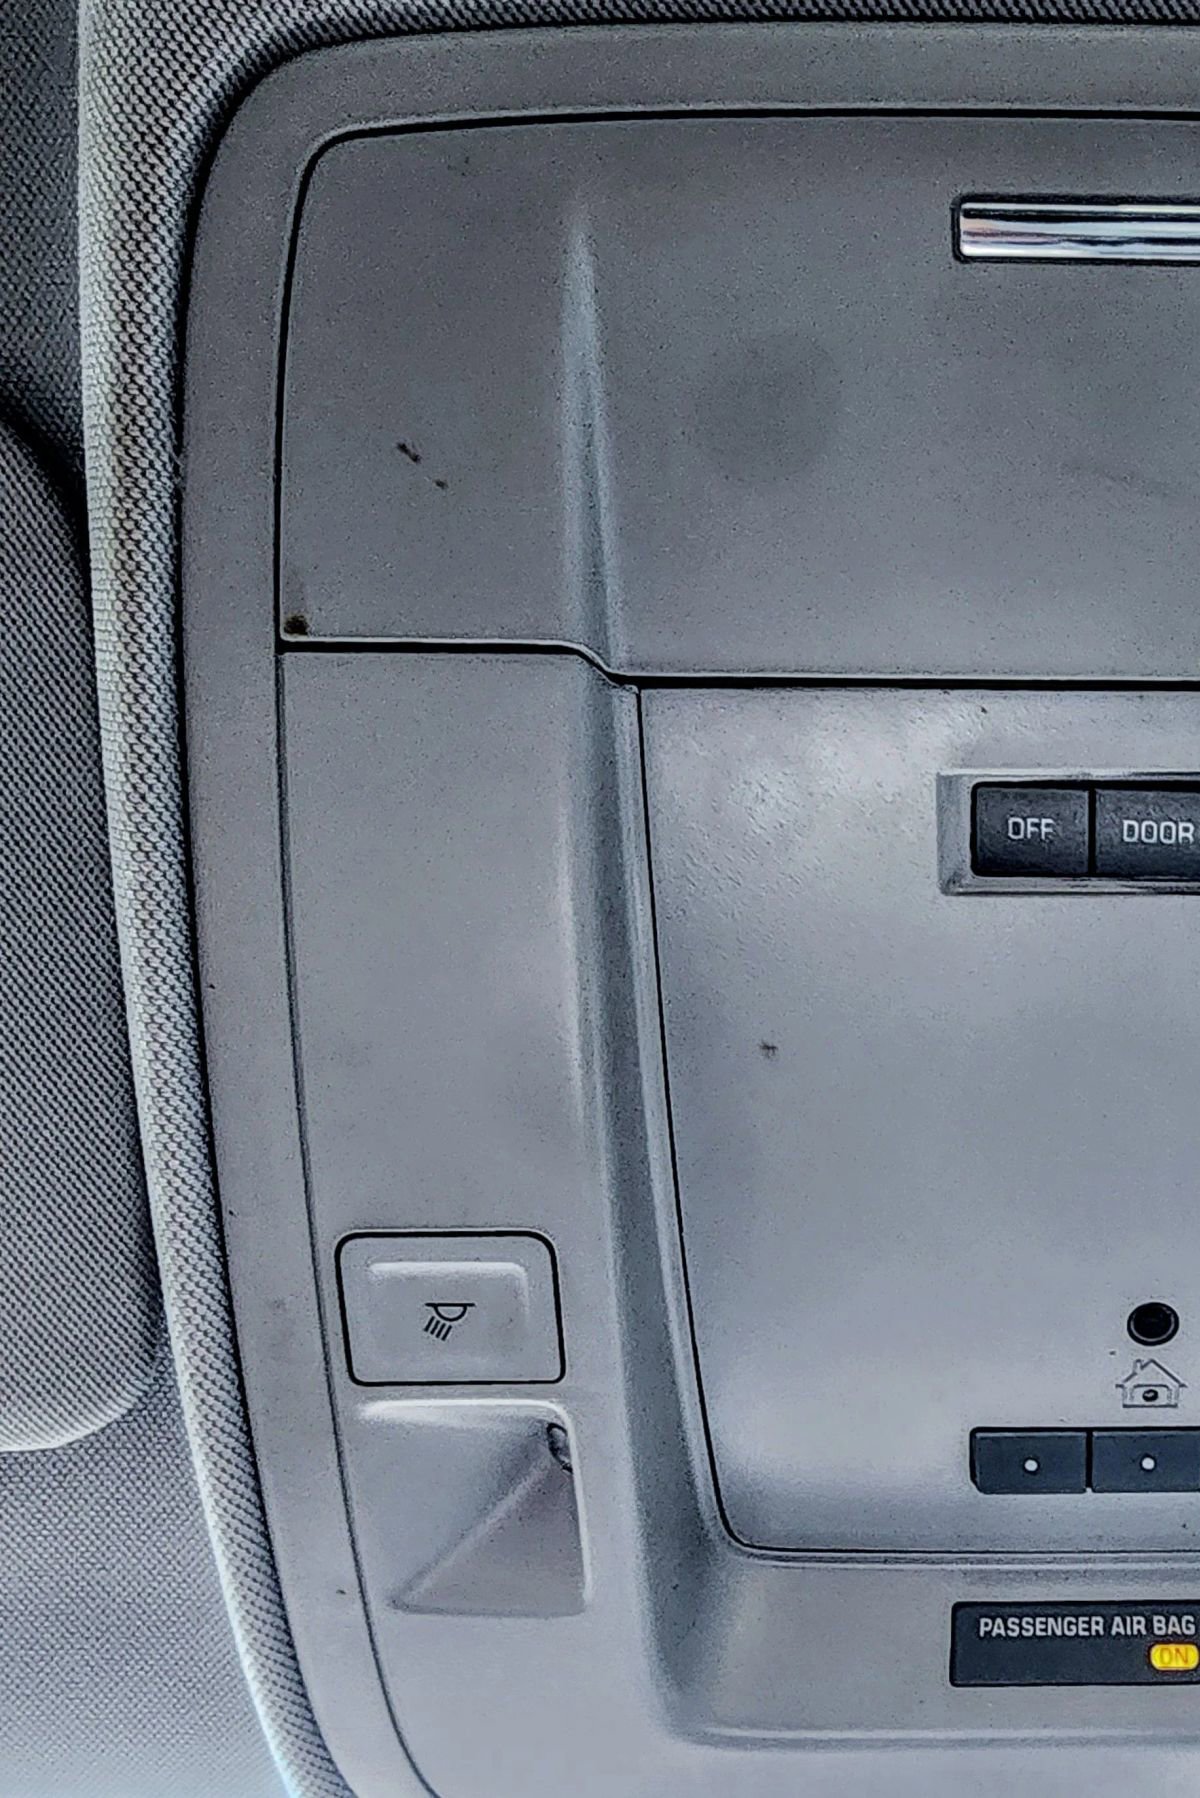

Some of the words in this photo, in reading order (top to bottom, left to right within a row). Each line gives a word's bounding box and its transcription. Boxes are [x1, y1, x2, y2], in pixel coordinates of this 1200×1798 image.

[1007, 817, 1055, 840] OFF
[1122, 819, 1195, 844] DOOR
[979, 1615, 1104, 1638] PASSENGER
[1110, 1615, 1147, 1636] AIR
[1153, 1614, 1196, 1636] BAG
[1159, 1646, 1190, 1667] ON
